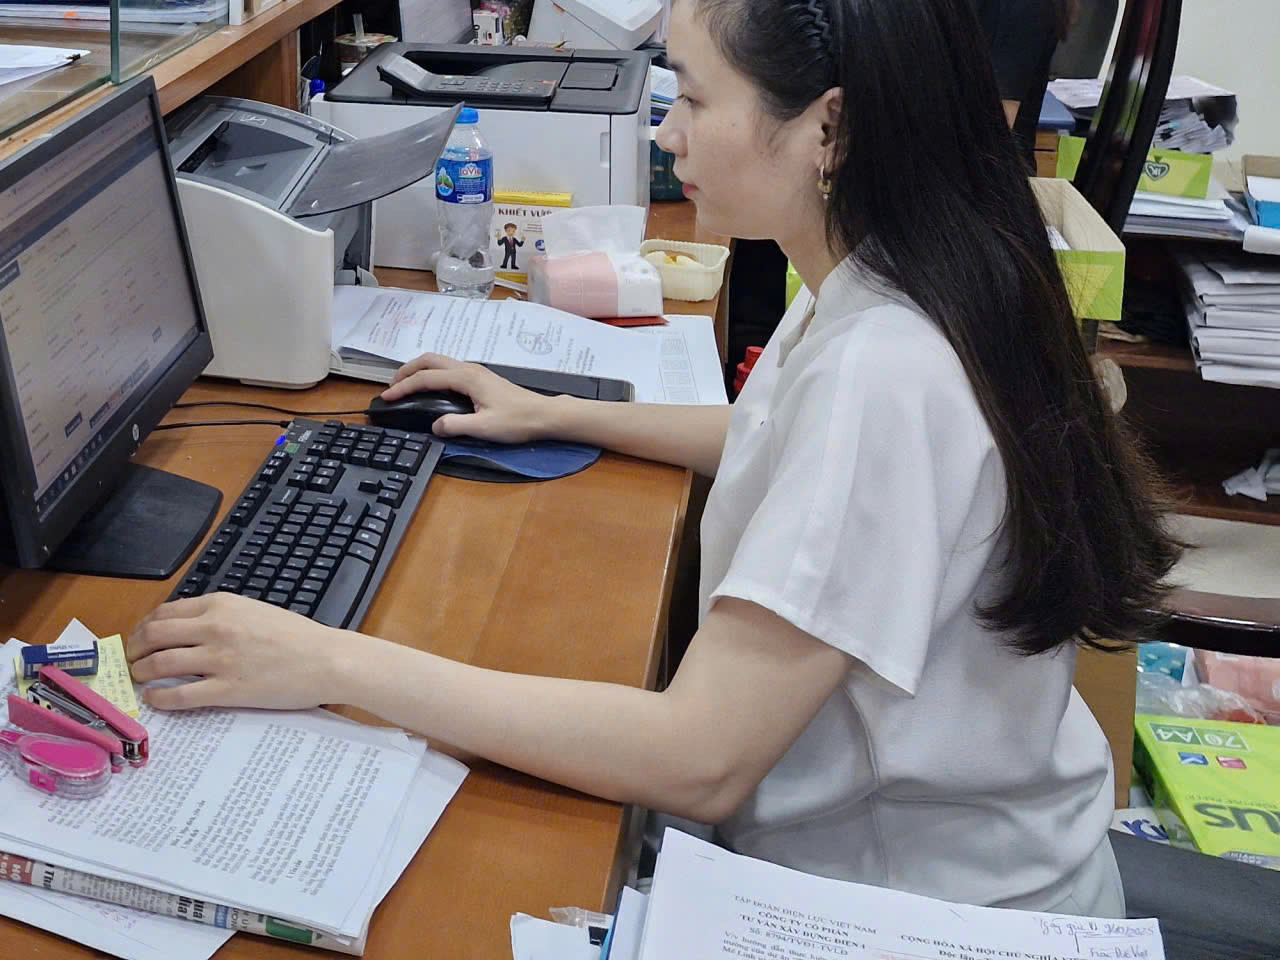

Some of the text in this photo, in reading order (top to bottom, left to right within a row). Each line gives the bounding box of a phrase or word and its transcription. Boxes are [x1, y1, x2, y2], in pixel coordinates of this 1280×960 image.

[498, 207, 527, 217] KHIẾT
[1156, 728, 1193, 743] A4
[1194, 803, 1280, 835] us
[758, 909, 787, 923] CÔNG
[790, 918, 801, 926] TY
[780, 924, 800, 935] XÂY
[854, 925, 876, 935] NAM
[900, 934, 930, 945] CỘNG
